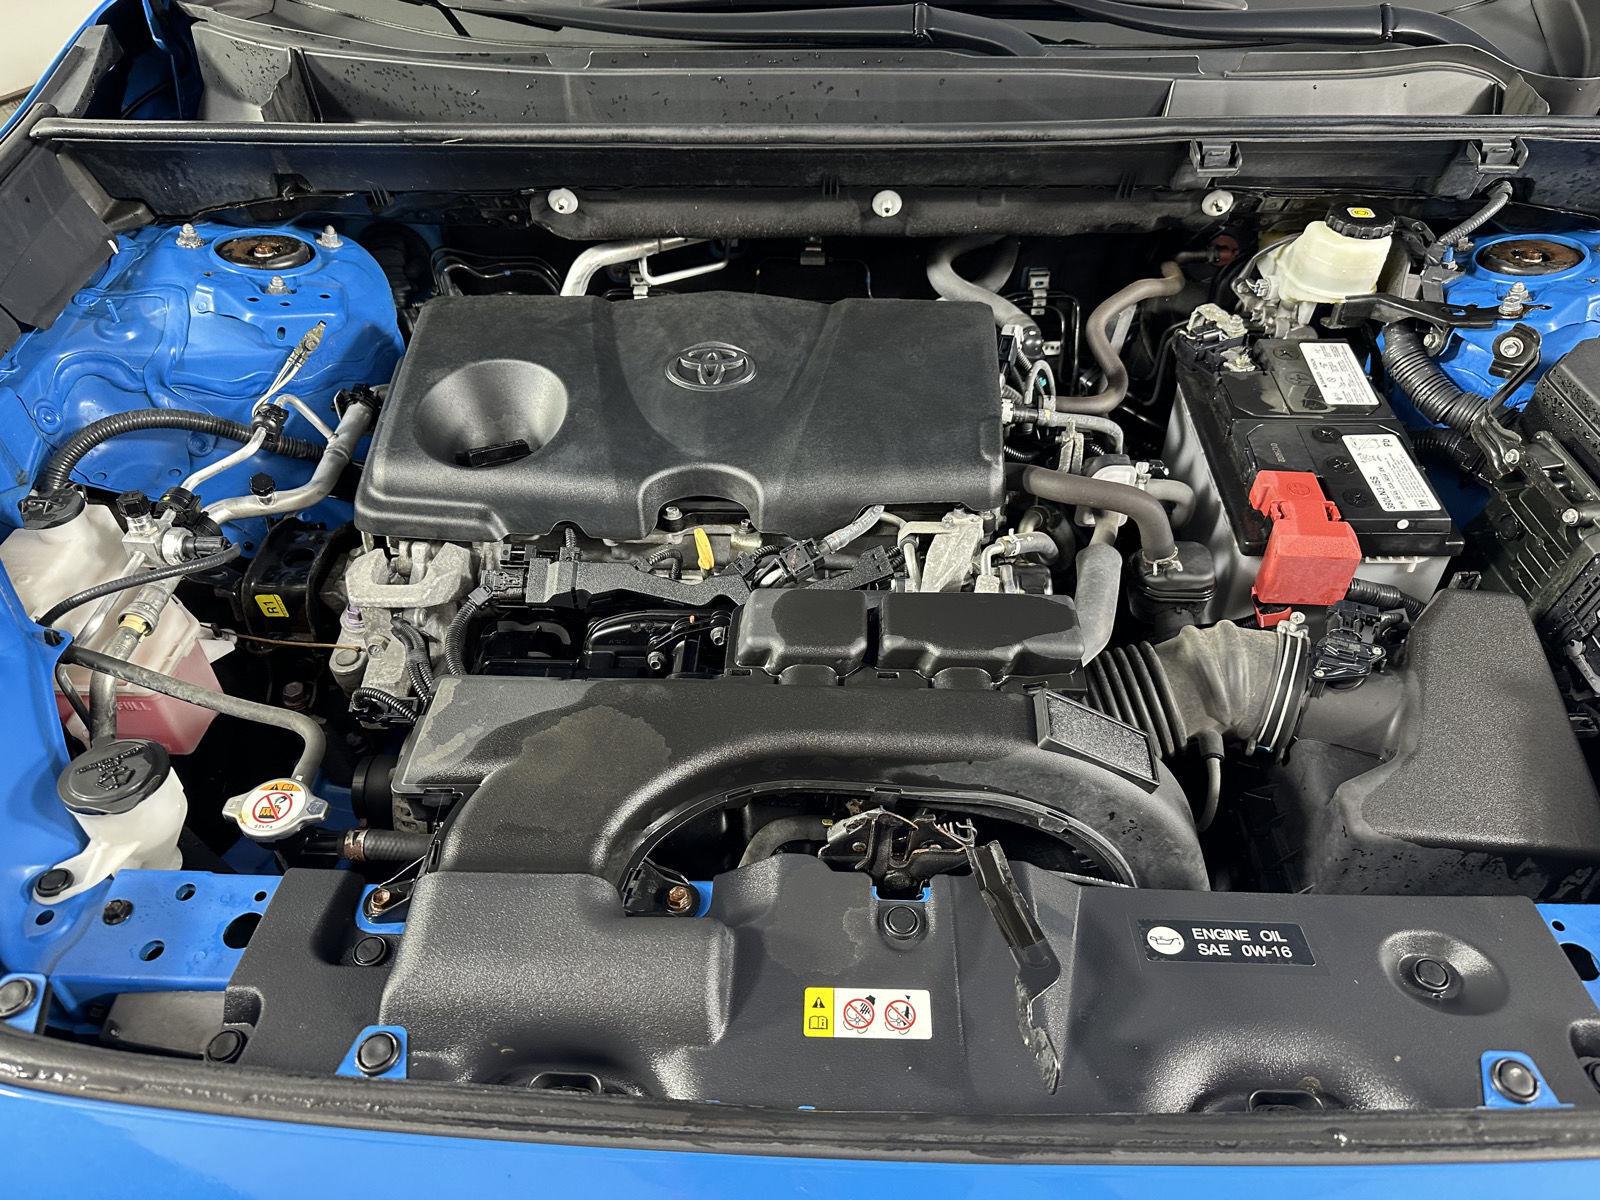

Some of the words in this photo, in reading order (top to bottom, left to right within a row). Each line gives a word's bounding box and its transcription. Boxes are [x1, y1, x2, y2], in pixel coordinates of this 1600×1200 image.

[263, 601, 280, 614] R1
[1191, 927, 1251, 942] ENGINE
[1259, 930, 1288, 943] OIL
[1197, 943, 1232, 956] SAE
[1241, 945, 1293, 958] 0W-16
